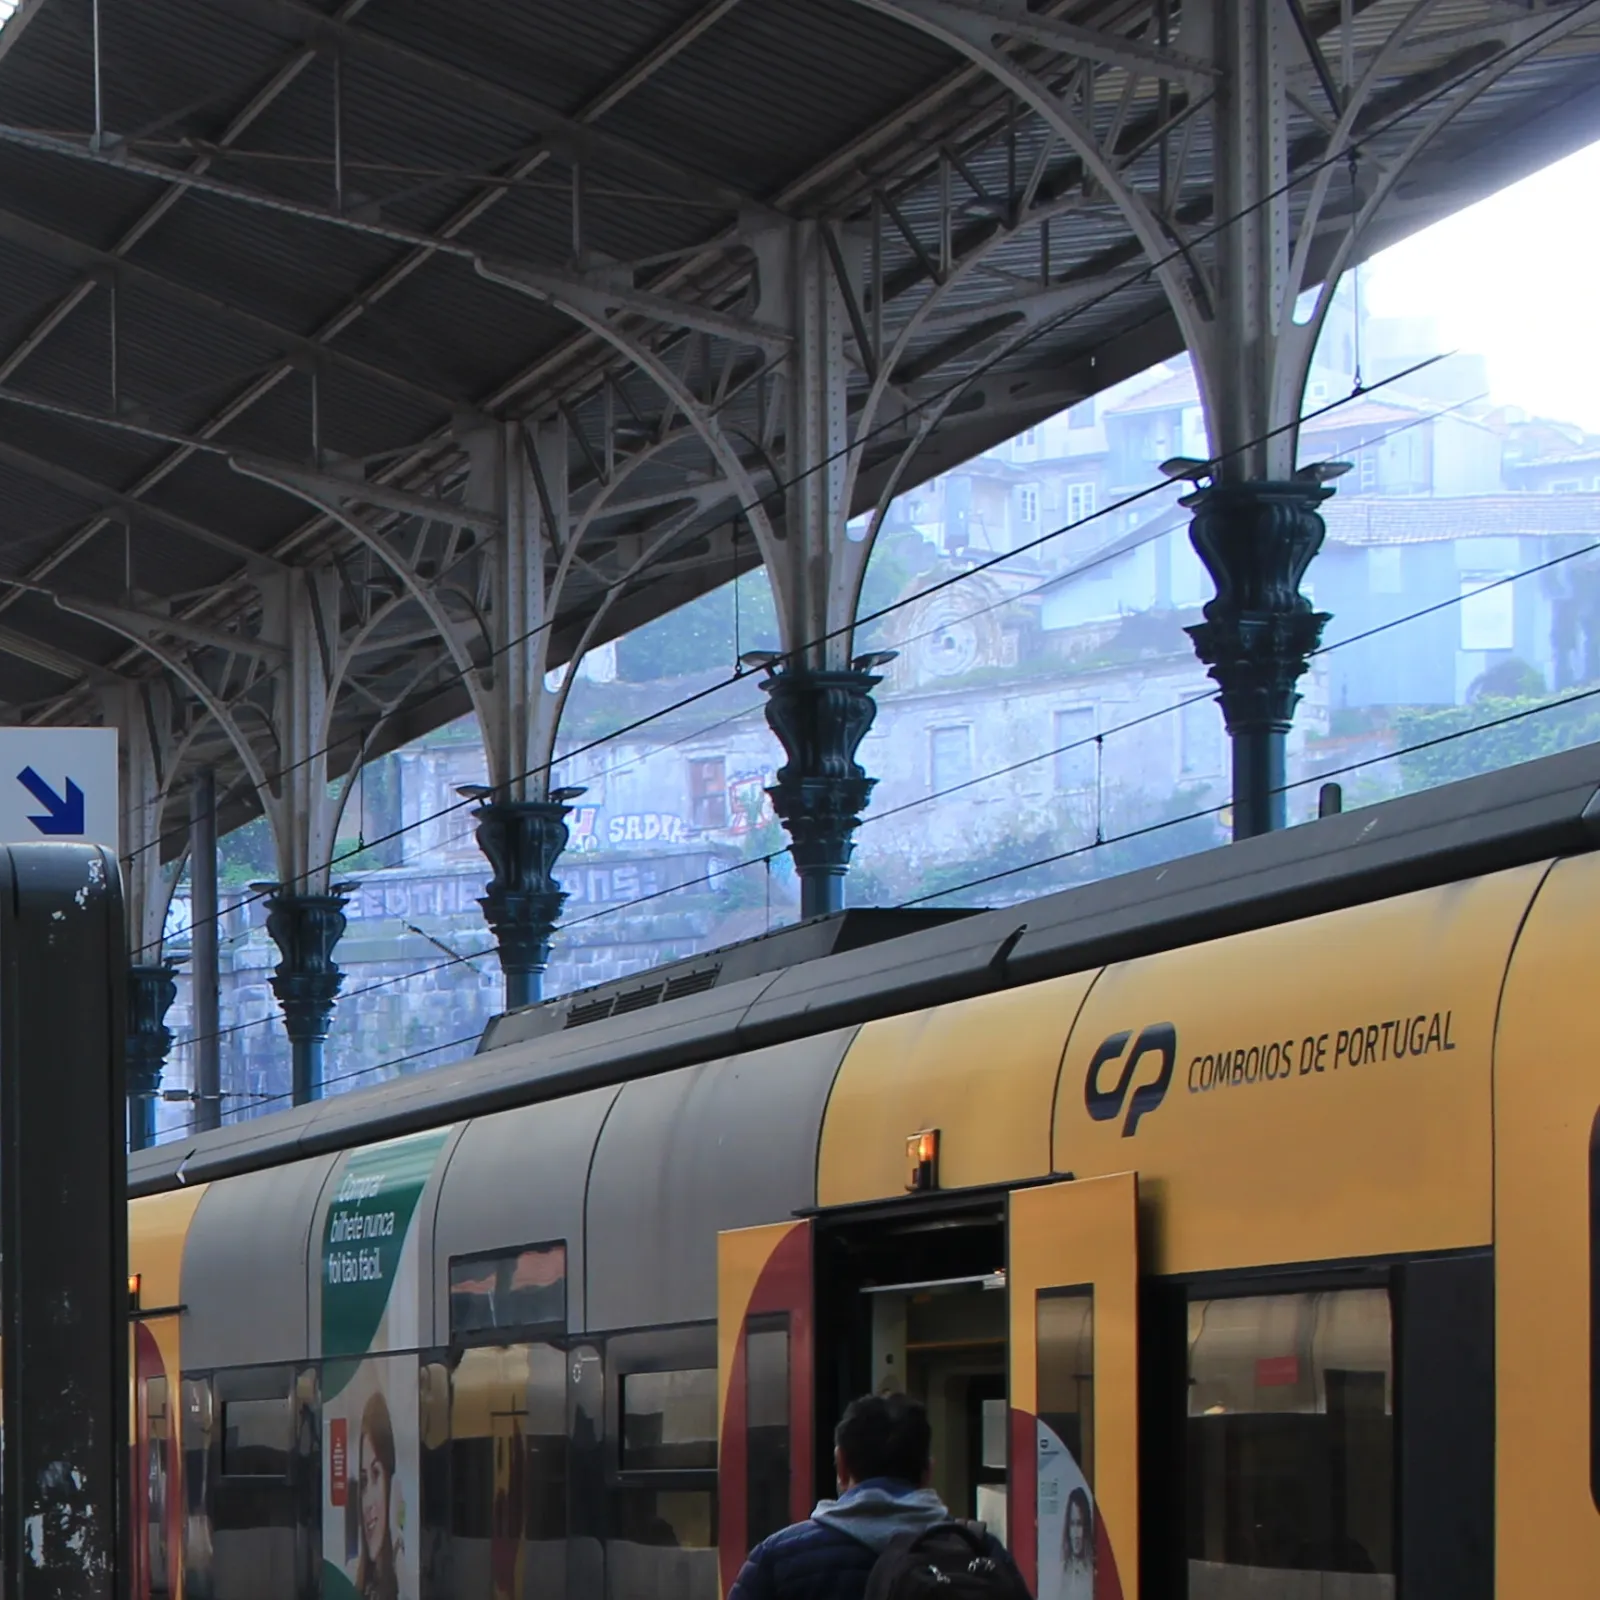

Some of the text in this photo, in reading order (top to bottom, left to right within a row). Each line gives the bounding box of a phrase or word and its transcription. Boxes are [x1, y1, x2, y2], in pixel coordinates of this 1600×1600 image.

[1188, 1010, 1456, 1094] COMBOIOS DE PORTUGAL
[338, 1173, 385, 1207] Comprar
[330, 1211, 395, 1243] bilhete nunca
[329, 1248, 383, 1284] foi tão fácil.
